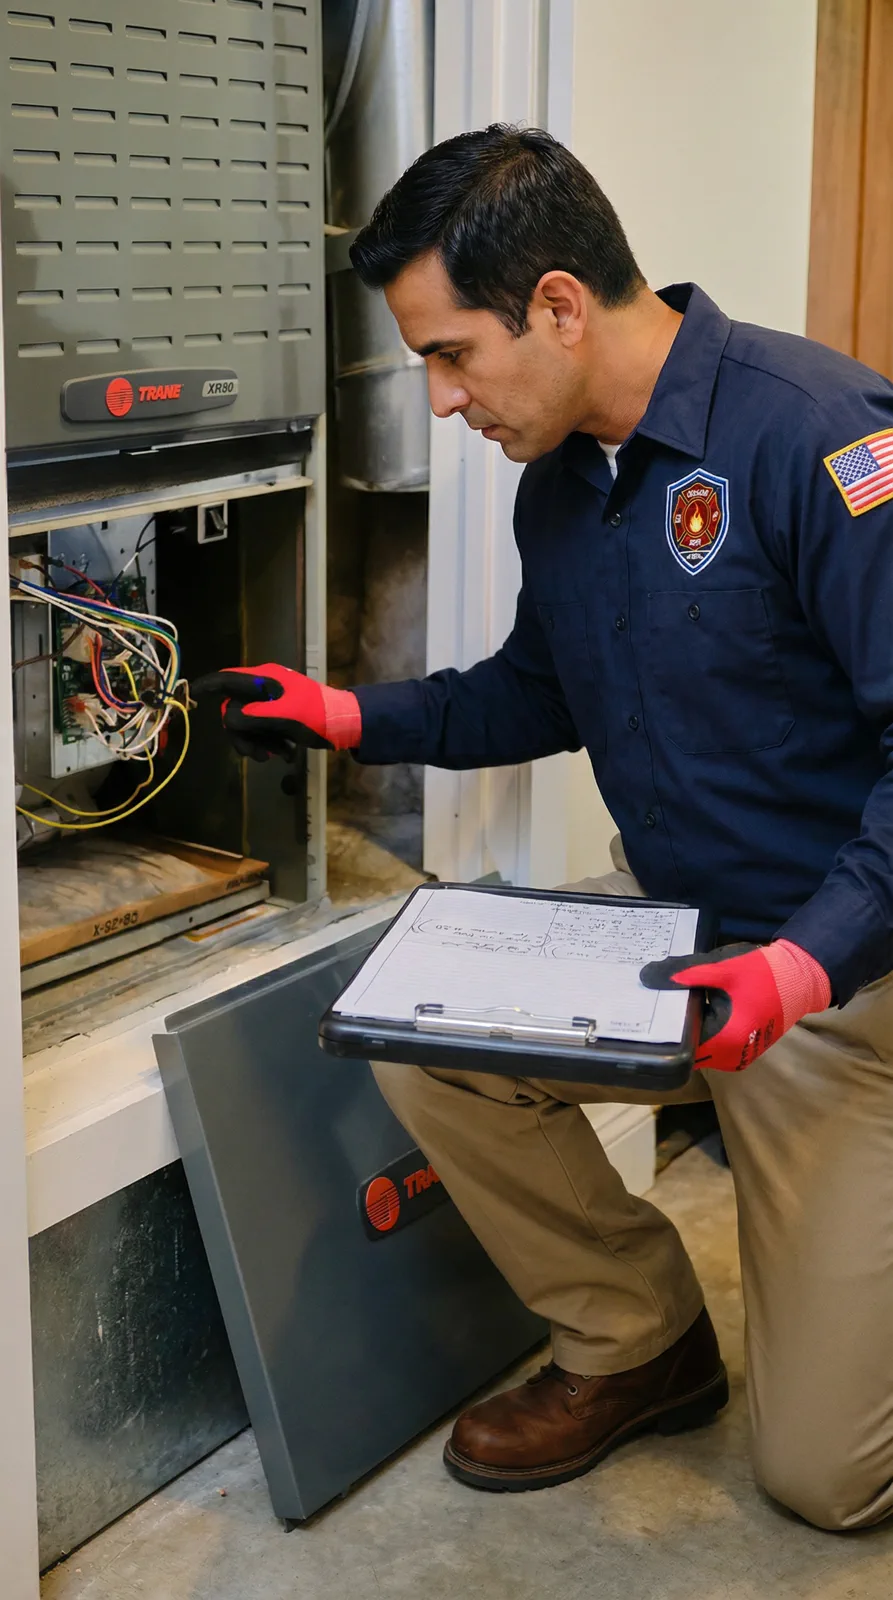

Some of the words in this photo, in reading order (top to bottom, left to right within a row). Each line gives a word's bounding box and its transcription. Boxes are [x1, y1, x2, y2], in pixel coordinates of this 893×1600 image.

[138, 384, 182, 402] TRANE
[206, 381, 234, 395] XR80
[403, 1164, 441, 1199] TRA
